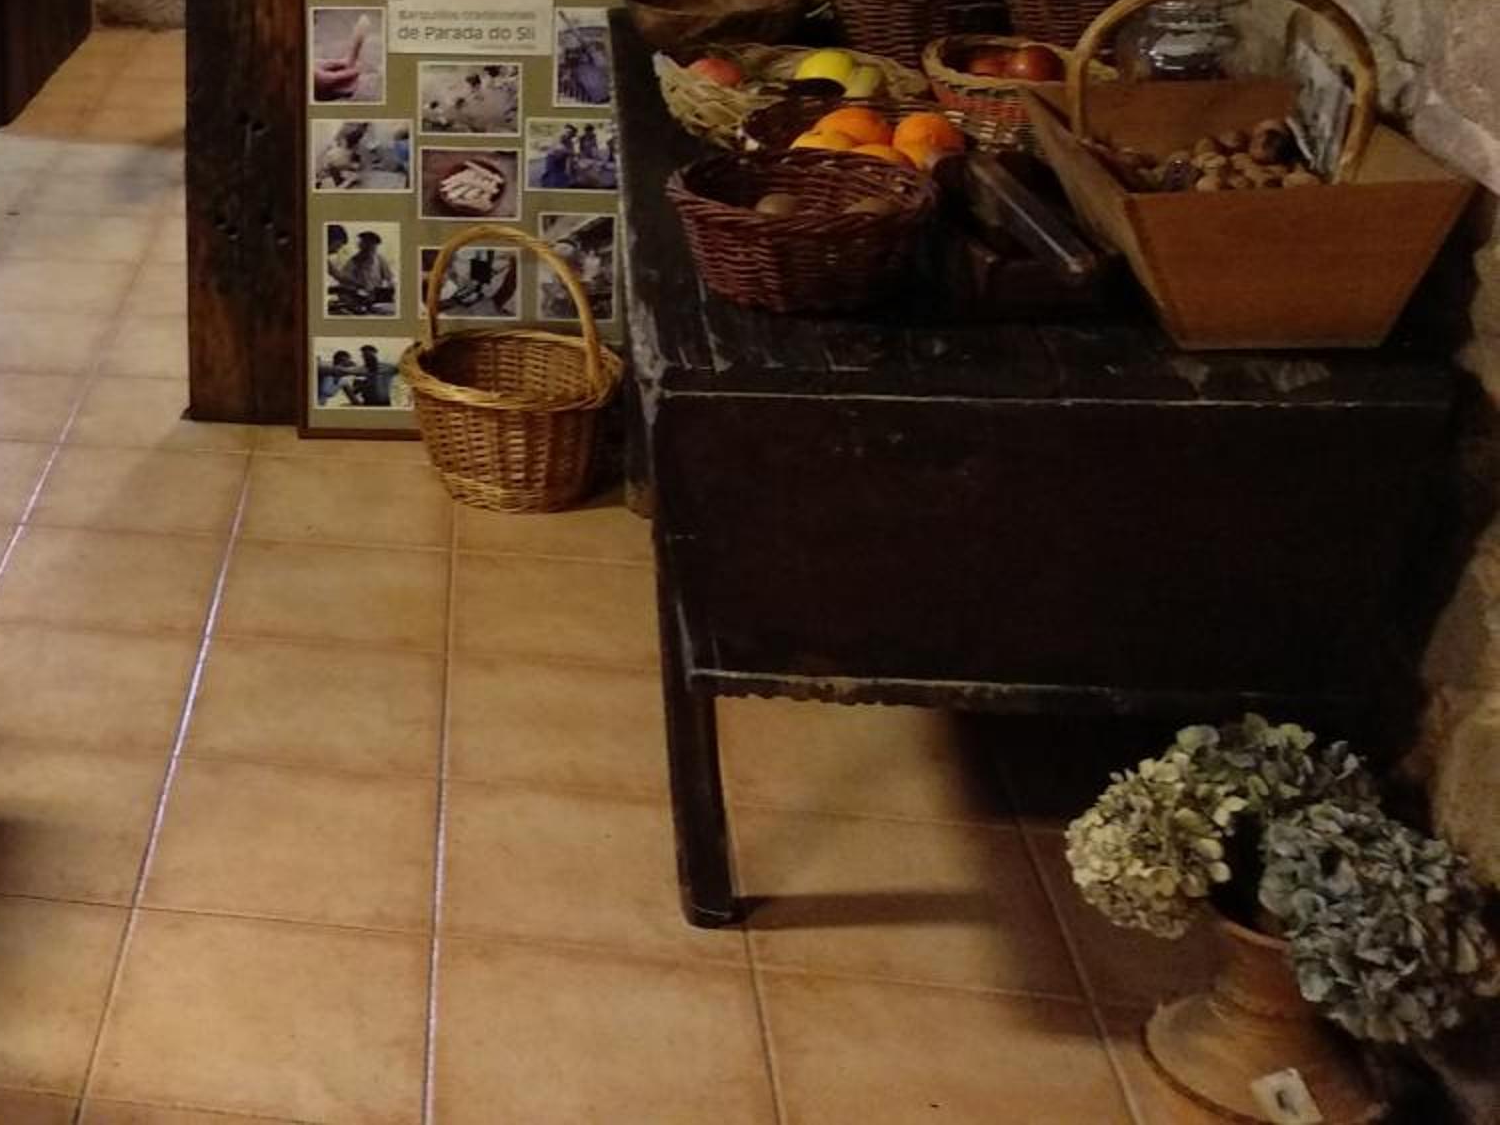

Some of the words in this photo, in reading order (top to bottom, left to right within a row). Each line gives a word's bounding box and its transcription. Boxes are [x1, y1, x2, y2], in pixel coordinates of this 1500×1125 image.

[398, 26, 420, 40] de
[424, 26, 483, 40] Parada
[488, 26, 512, 40] do
